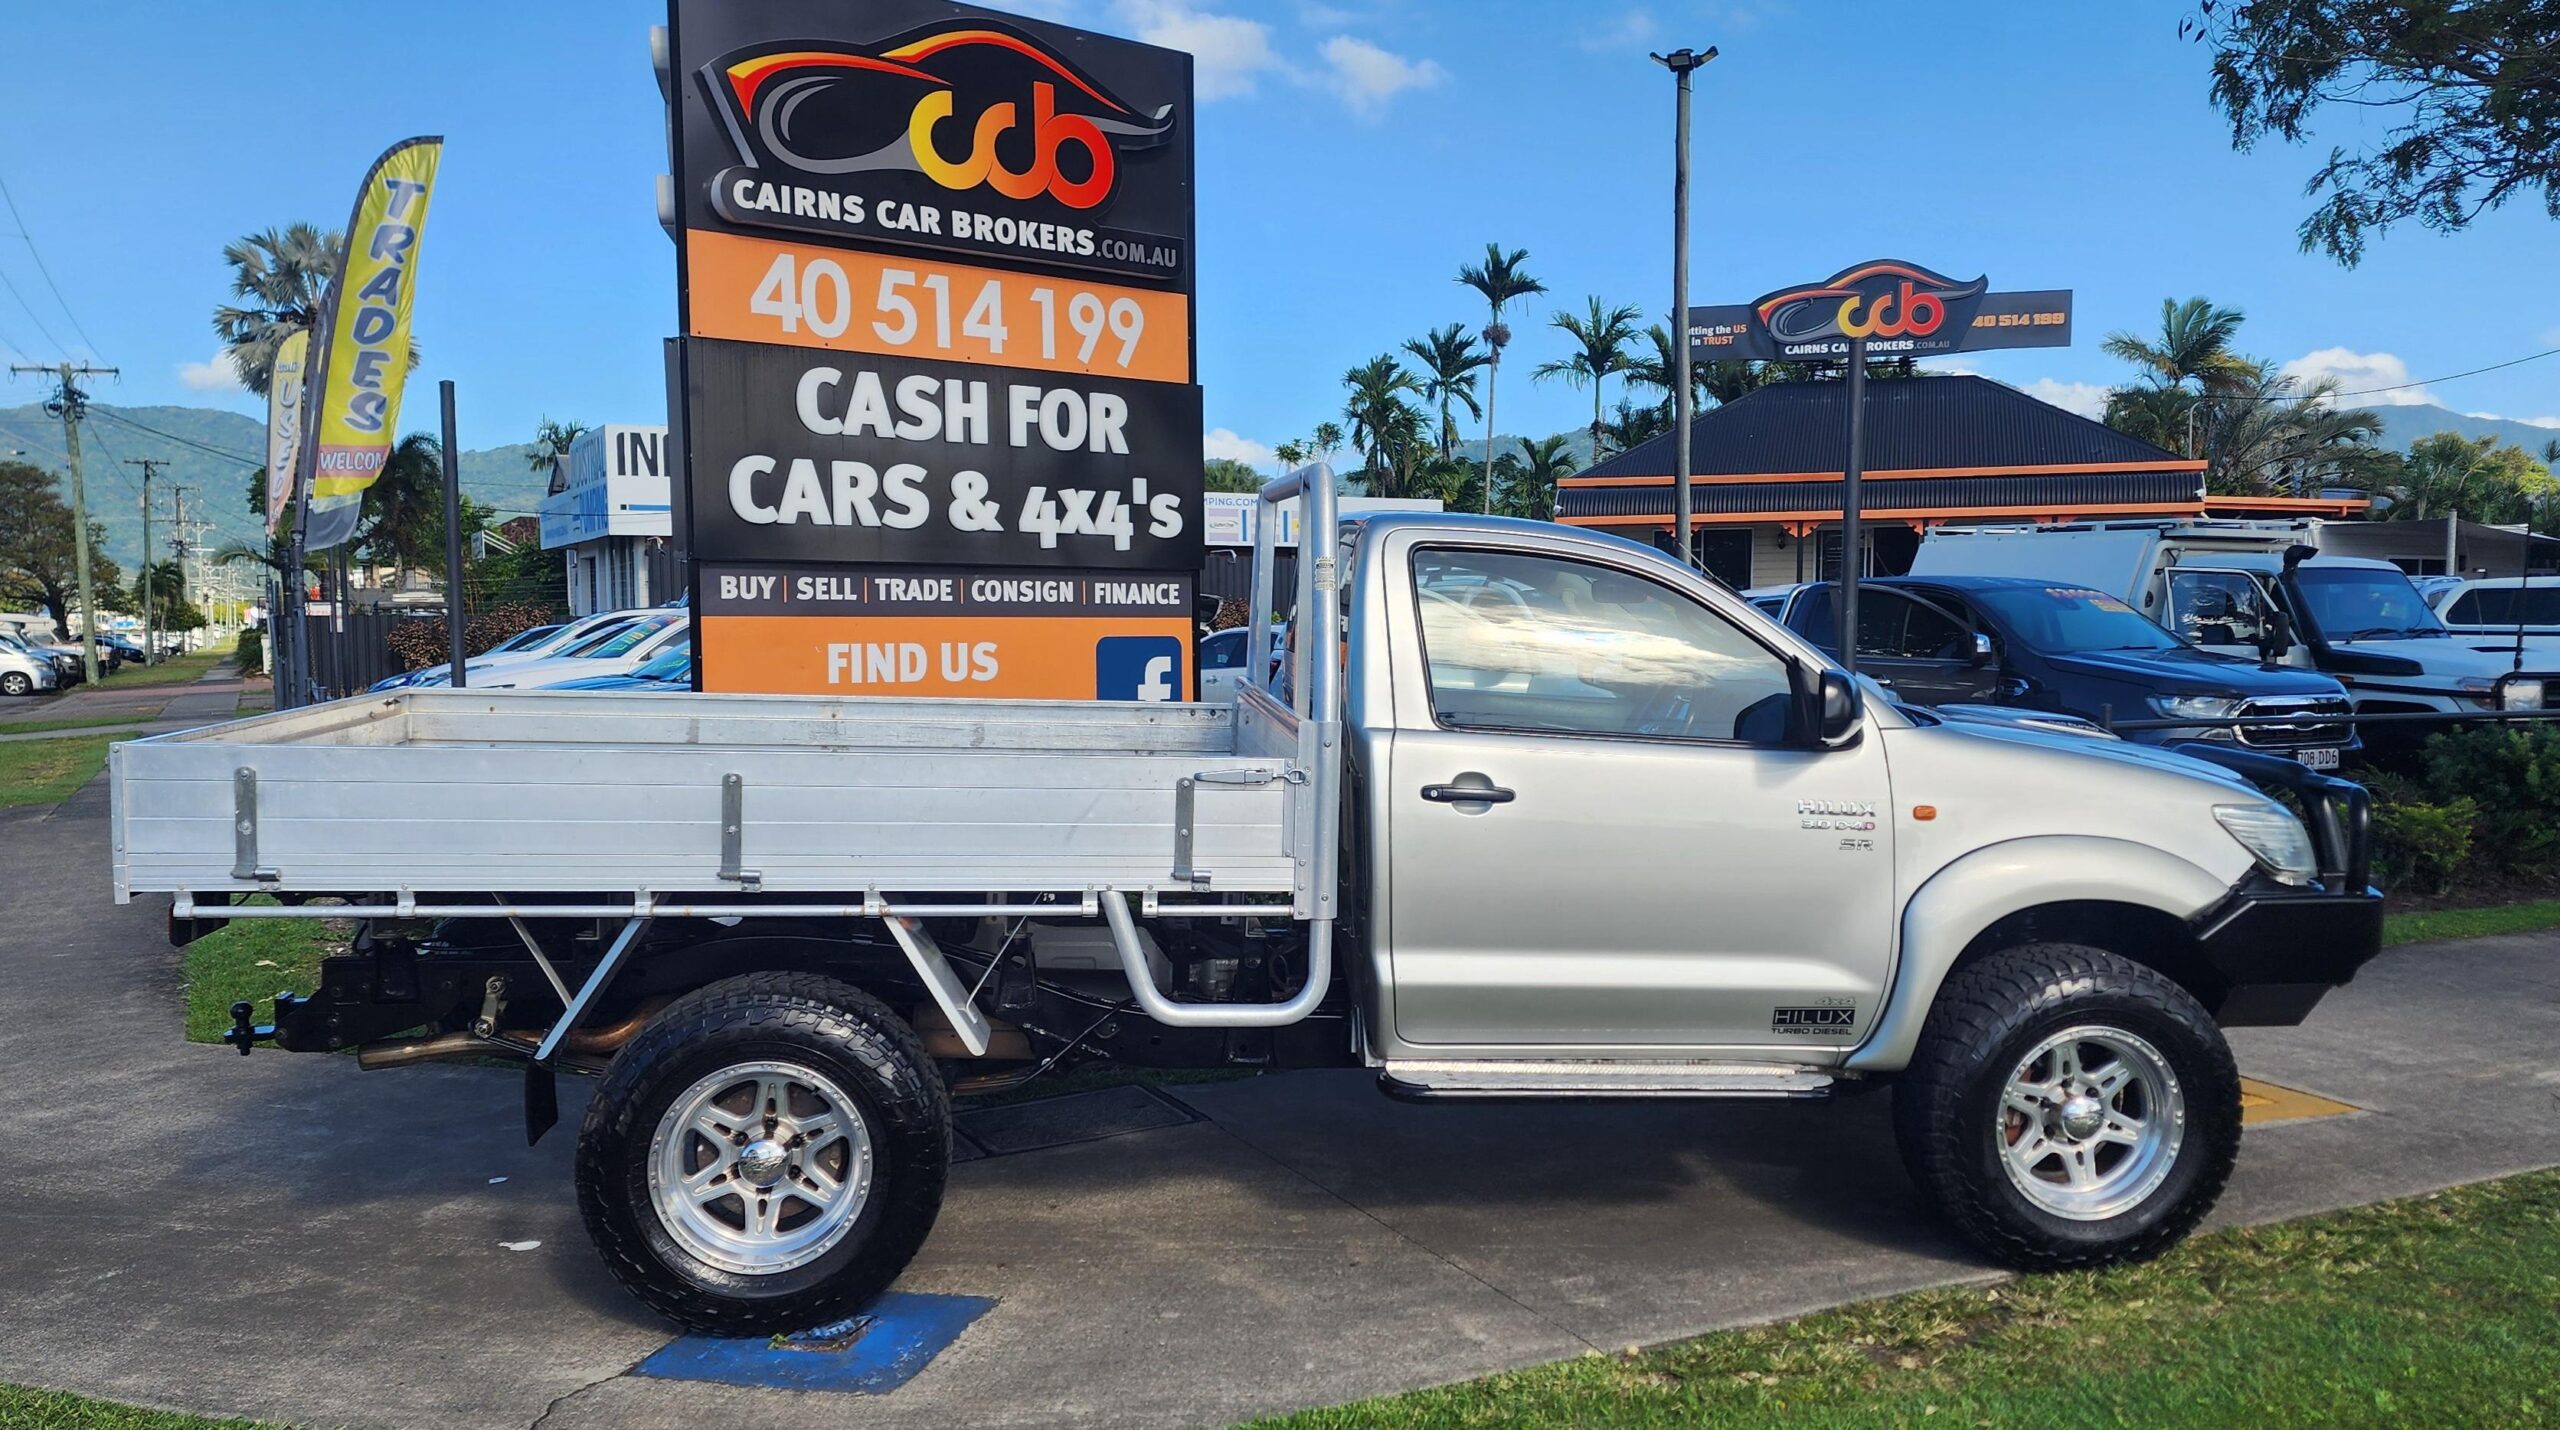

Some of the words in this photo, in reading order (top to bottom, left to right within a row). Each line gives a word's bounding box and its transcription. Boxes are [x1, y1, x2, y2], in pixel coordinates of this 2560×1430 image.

[732, 179, 866, 224] CAIRNS
[876, 200, 942, 235] CAR
[951, 210, 1177, 268] BROKERS.COM.AU
[344, 179, 426, 432] TRADES
[750, 253, 851, 338] 40
[872, 268, 1008, 354] 514
[1030, 287, 1145, 369] 199
[1689, 326, 1714, 336] tting
[1715, 325, 1731, 334] the
[1733, 324, 1747, 333] US
[1972, 315, 1997, 328] 40
[1998, 313, 2030, 327] 514
[1691, 336, 1701, 346] in
[1703, 336, 1734, 346] TRUST
[1784, 344, 1829, 355] CAIRNS
[1831, 342, 1849, 353] CA
[1866, 340, 1950, 352] ROKERS.COM.AU
[796, 366, 989, 445] CASH
[1008, 384, 1130, 455] FOR
[616, 432, 672, 477] IN
[728, 454, 930, 529] CARS
[947, 470, 1004, 533] &
[720, 575, 776, 601] BUY
[796, 576, 858, 601] SELL
[875, 578, 953, 602] TRADE
[971, 580, 1074, 604] CONSIGN
[1094, 582, 1181, 606] FINANCE
[827, 642, 928, 684] FIND
[940, 641, 999, 682] US
[1798, 799, 1876, 817] HILUX
[1839, 838, 1874, 851] SR
[1773, 1010, 1853, 1024] HILUX
[1812, 1028, 1852, 1036] DIESEL
